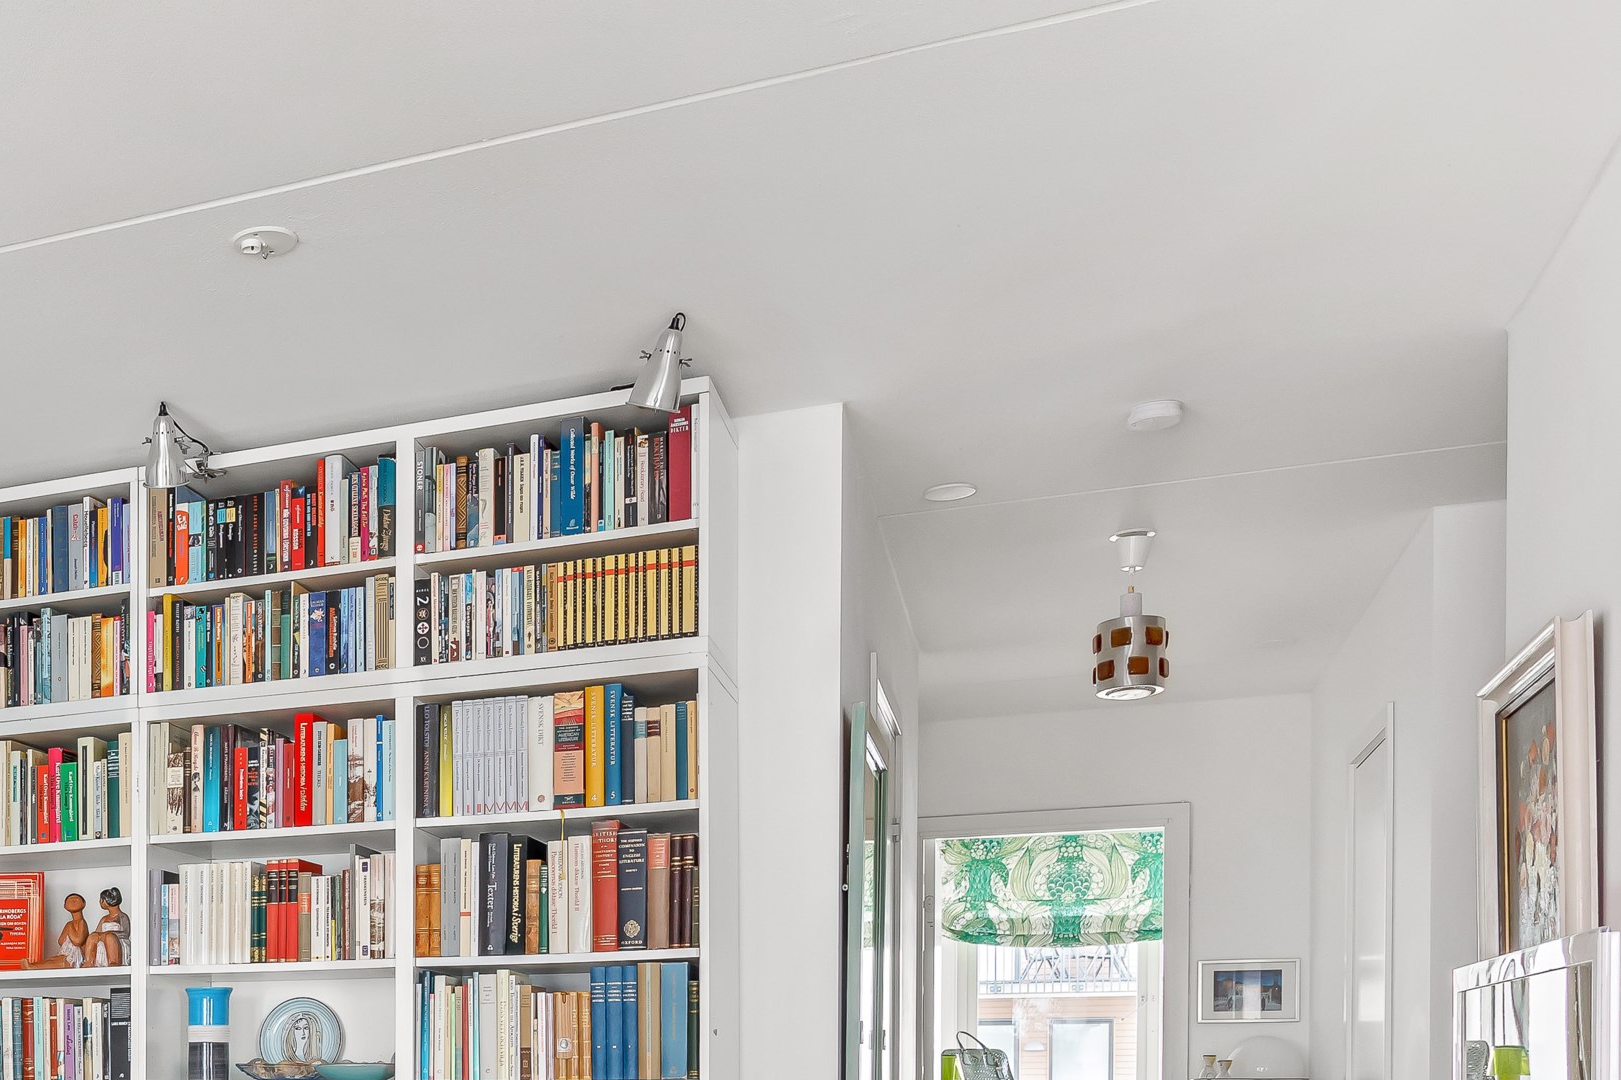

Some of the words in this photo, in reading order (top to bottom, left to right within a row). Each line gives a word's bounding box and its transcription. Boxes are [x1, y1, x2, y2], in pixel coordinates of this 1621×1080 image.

[569, 427, 577, 449] Collected
[569, 449, 577, 464] Works
[416, 461, 424, 491] STONER
[569, 470, 577, 485] Oscar
[569, 485, 577, 500] Wilde
[416, 595, 429, 606] 2
[590, 691, 598, 710] SVENSK
[609, 689, 617, 710] SVENSK
[537, 702, 546, 727] SVENSK
[537, 727, 546, 746] DIKT
[590, 710, 598, 768] LITTERATUR
[609, 710, 617, 766] LITTERATUR
[422, 750, 431, 769] ANNA
[422, 769, 431, 808] KARENINA
[609, 791, 617, 801] 5
[486, 882, 498, 910] Texter
[511, 886, 520, 912] HISTORIA
